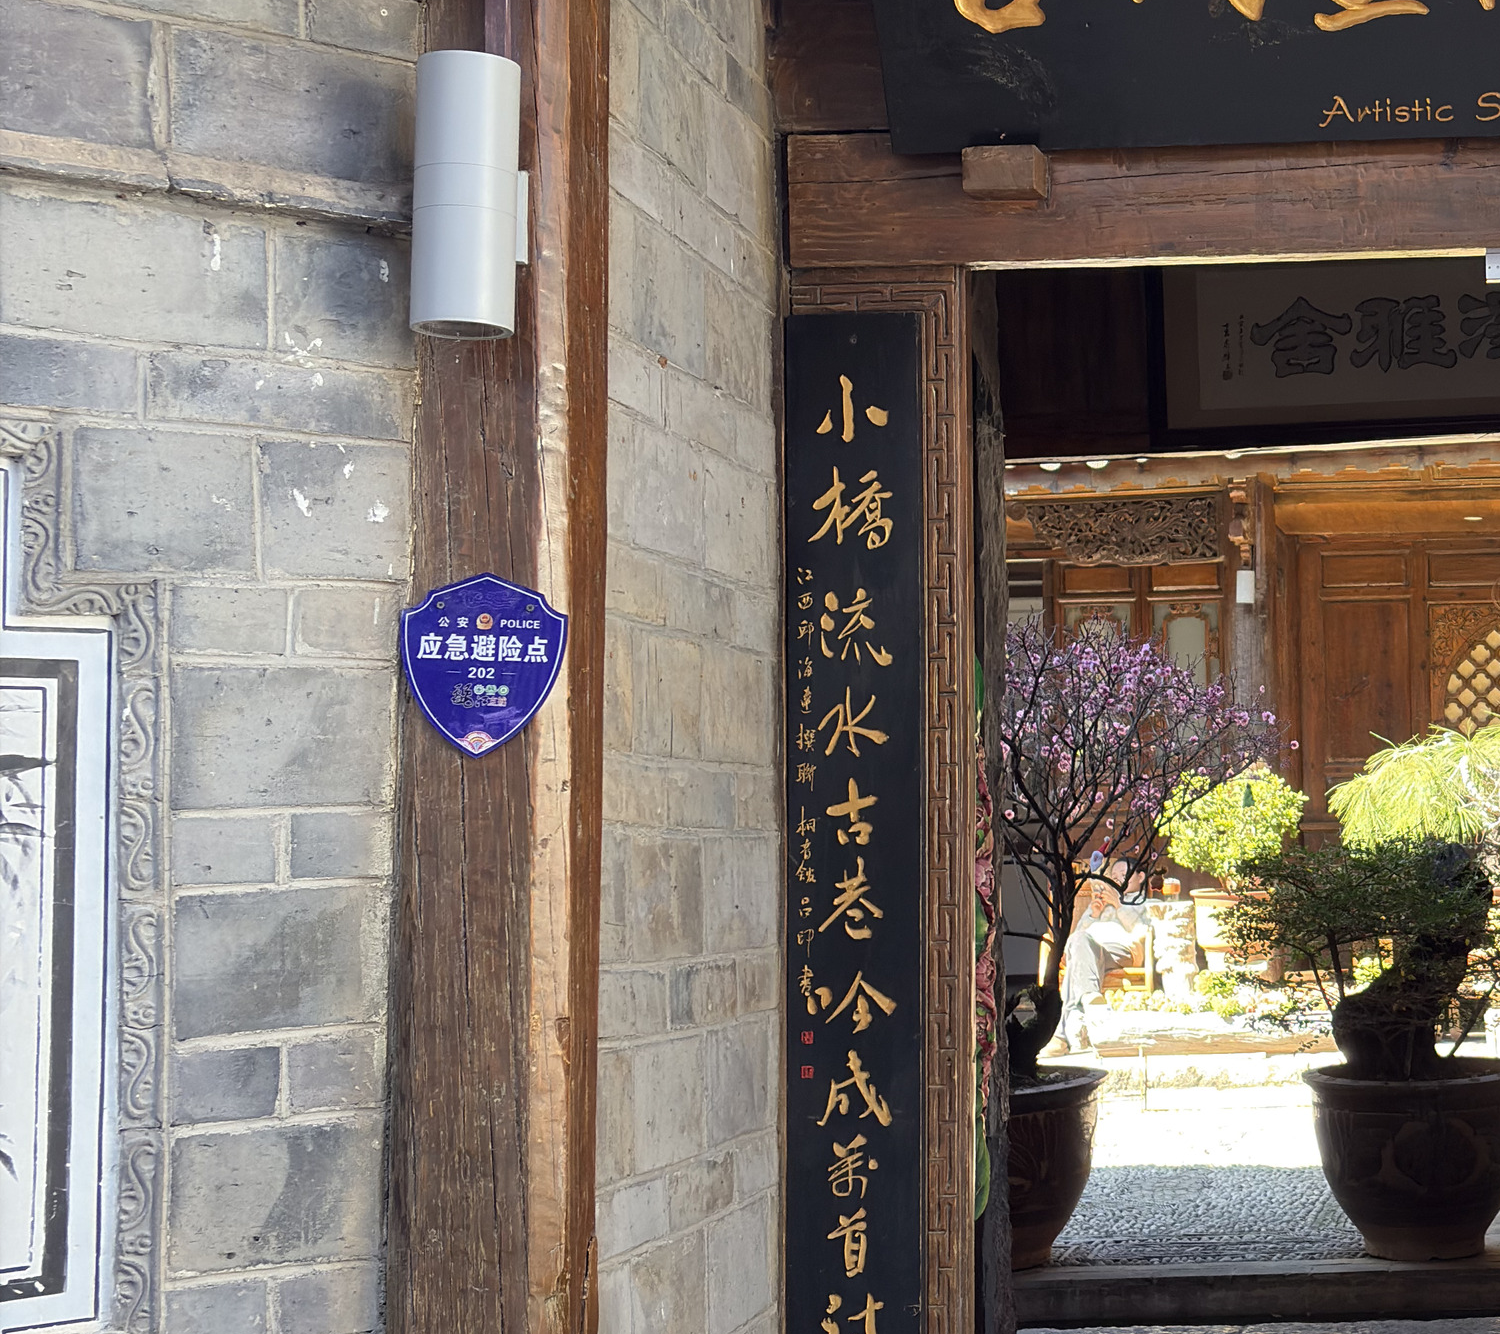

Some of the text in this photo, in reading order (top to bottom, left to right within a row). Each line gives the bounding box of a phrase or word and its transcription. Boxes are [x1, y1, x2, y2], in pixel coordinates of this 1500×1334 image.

[1319, 95, 1454, 128] Artistic
[438, 616, 541, 629] 公安 POLICE
[416, 632, 549, 663] 应急避险点
[467, 667, 495, 679] 202
